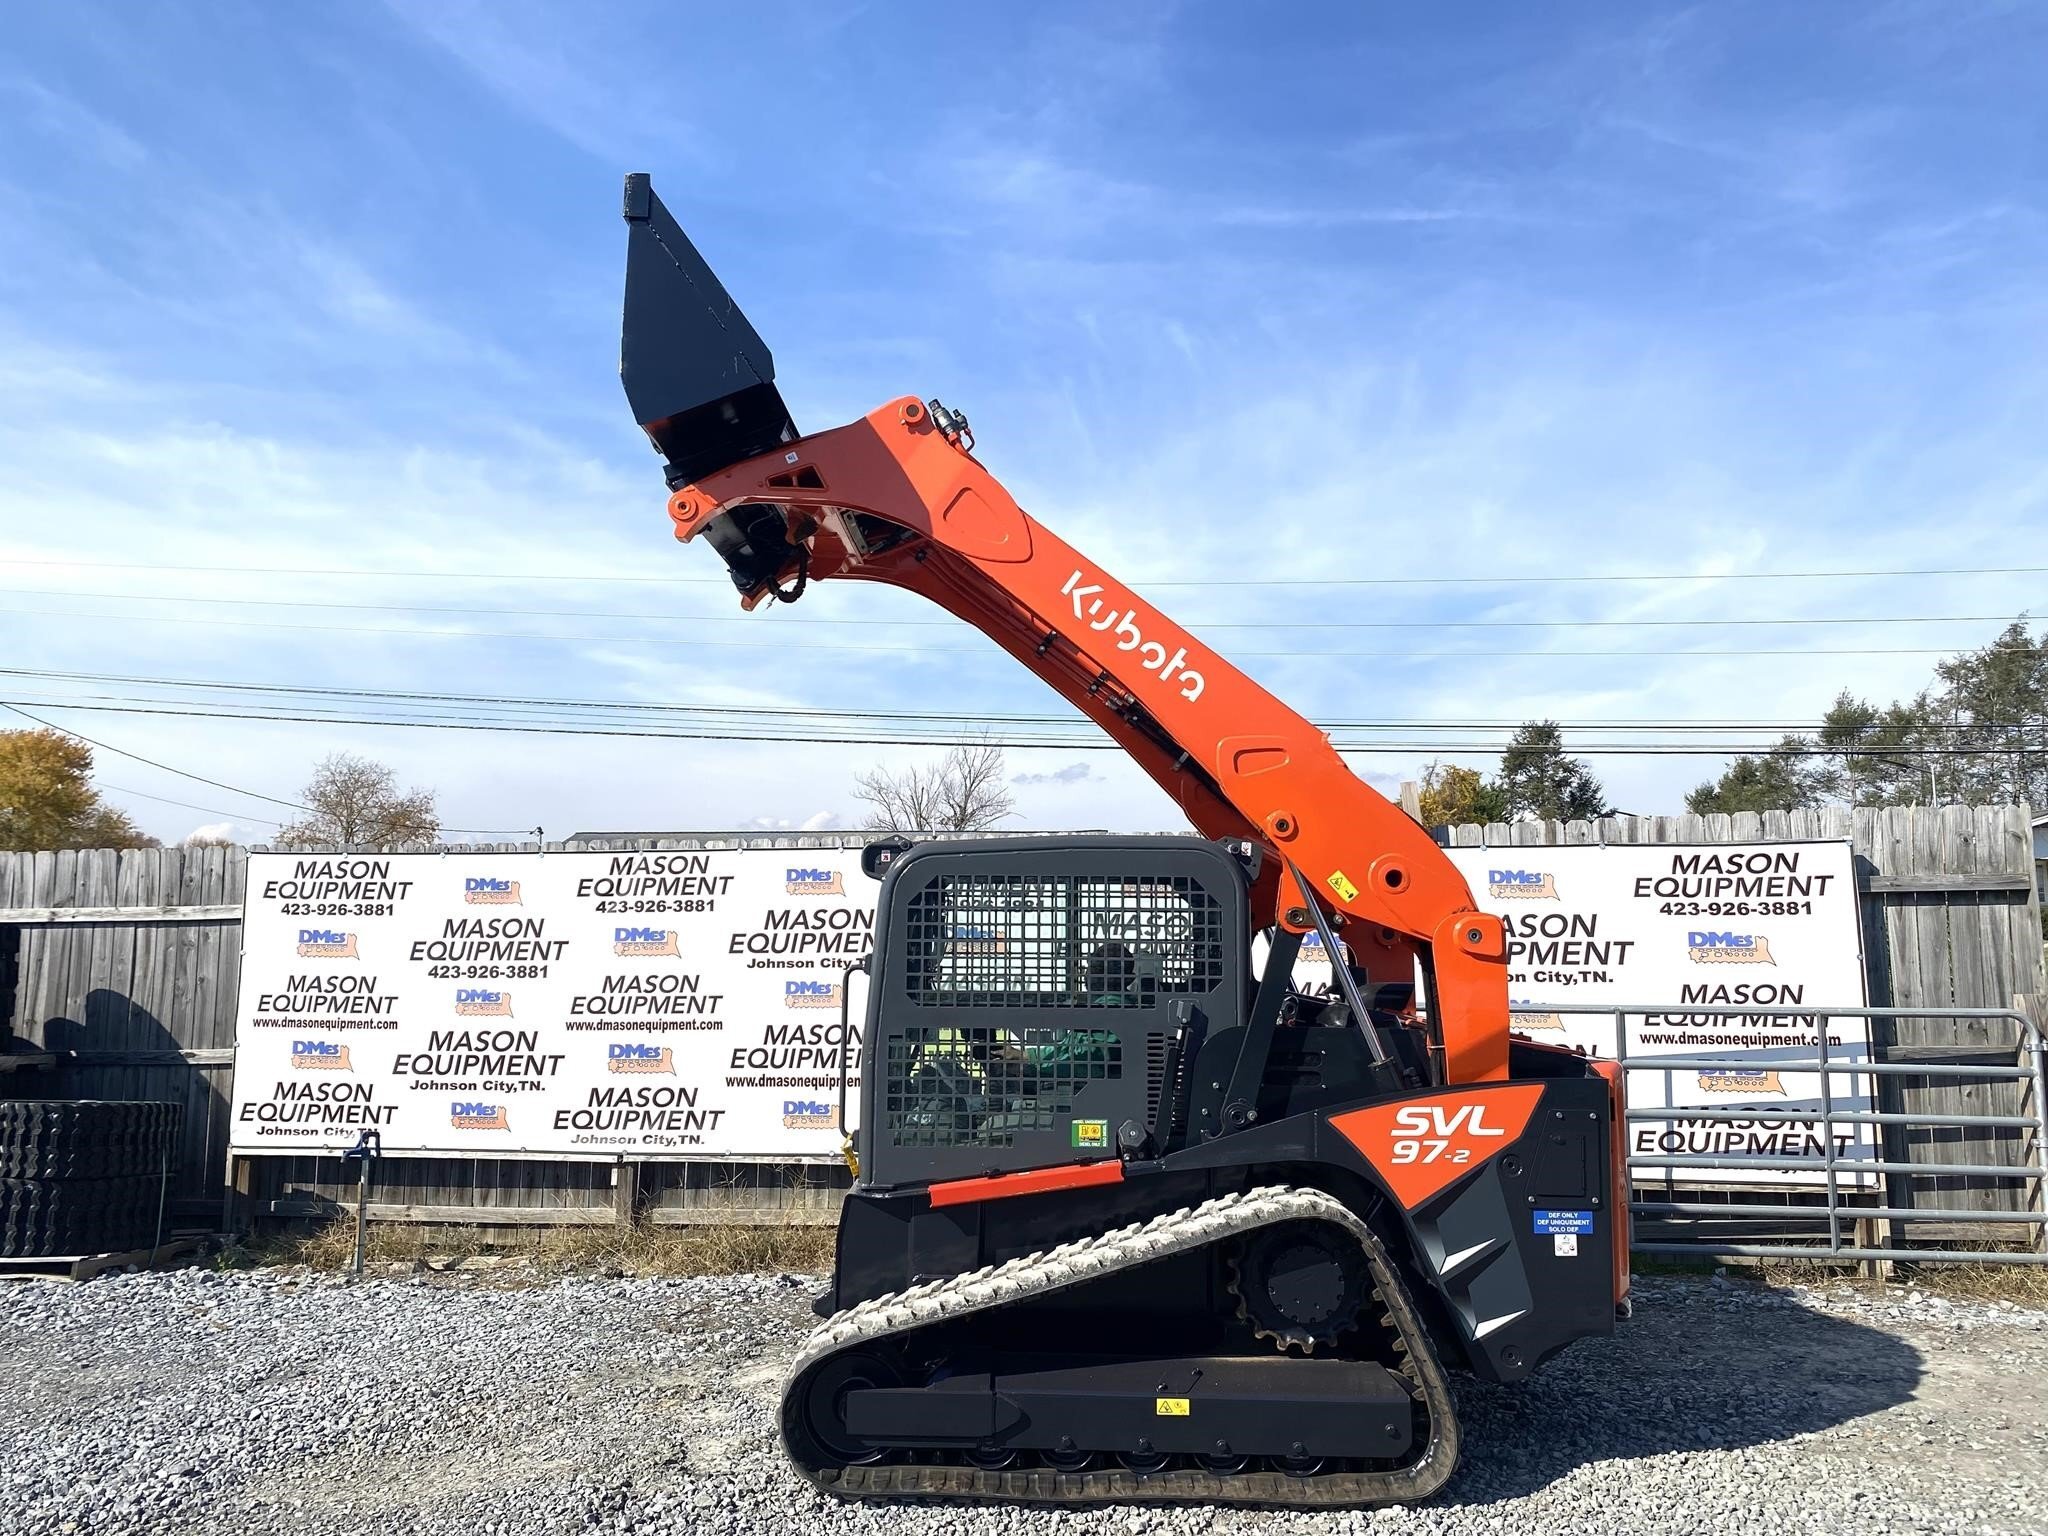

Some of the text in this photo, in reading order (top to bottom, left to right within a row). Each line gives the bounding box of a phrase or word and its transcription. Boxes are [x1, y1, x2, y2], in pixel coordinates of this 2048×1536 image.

[1060, 569, 1205, 703] Kubota
[293, 861, 390, 880] MASON
[608, 855, 710, 875] MASON
[1672, 852, 1800, 875] MASON
[262, 881, 413, 900] EQUIPMENT
[576, 876, 735, 897] EQUIPMENT
[1633, 875, 1835, 898] EQUIPMENT
[280, 903, 394, 917] 423-926-3881
[595, 899, 715, 914] 423-926-3881
[1659, 901, 1812, 916] 423-926-3881
[442, 918, 545, 939] MASON
[763, 908, 875, 931] MASON
[408, 940, 569, 961] EQUIPMENT
[427, 965, 549, 979] 423-926-3881
[746, 958, 815, 969] Johnson
[286, 975, 377, 994] MASON
[602, 974, 700, 994] MASON
[1534, 971, 1614, 986] City,TN.
[257, 994, 399, 1014] EQUIPMENT
[1680, 984, 1804, 1005] MASON
[570, 995, 723, 1015] EQUIPMENT
[253, 1016, 398, 1032] www.dmasonequipment.com
[565, 1018, 723, 1033] www.dmasonequipment.com
[427, 1030, 539, 1052] MASON
[1640, 1031, 1841, 1048] www.dmasonequipment.cm
[391, 1054, 566, 1077] EQUIPMENT
[273, 1081, 374, 1102] MASON
[409, 1080, 546, 1093] Johnson City,TN.
[587, 1087, 699, 1107] MASON
[239, 1102, 399, 1124] EQUIPMENT
[552, 1109, 726, 1130] EQUIPMENT
[1390, 1105, 1505, 1137] SVL
[256, 1126, 319, 1136] Johnson
[570, 1134, 705, 1147] Johnson City,TN.
[1391, 1139, 1471, 1164] 97-2
[1636, 1130, 1855, 1157] EQUIPMENT
